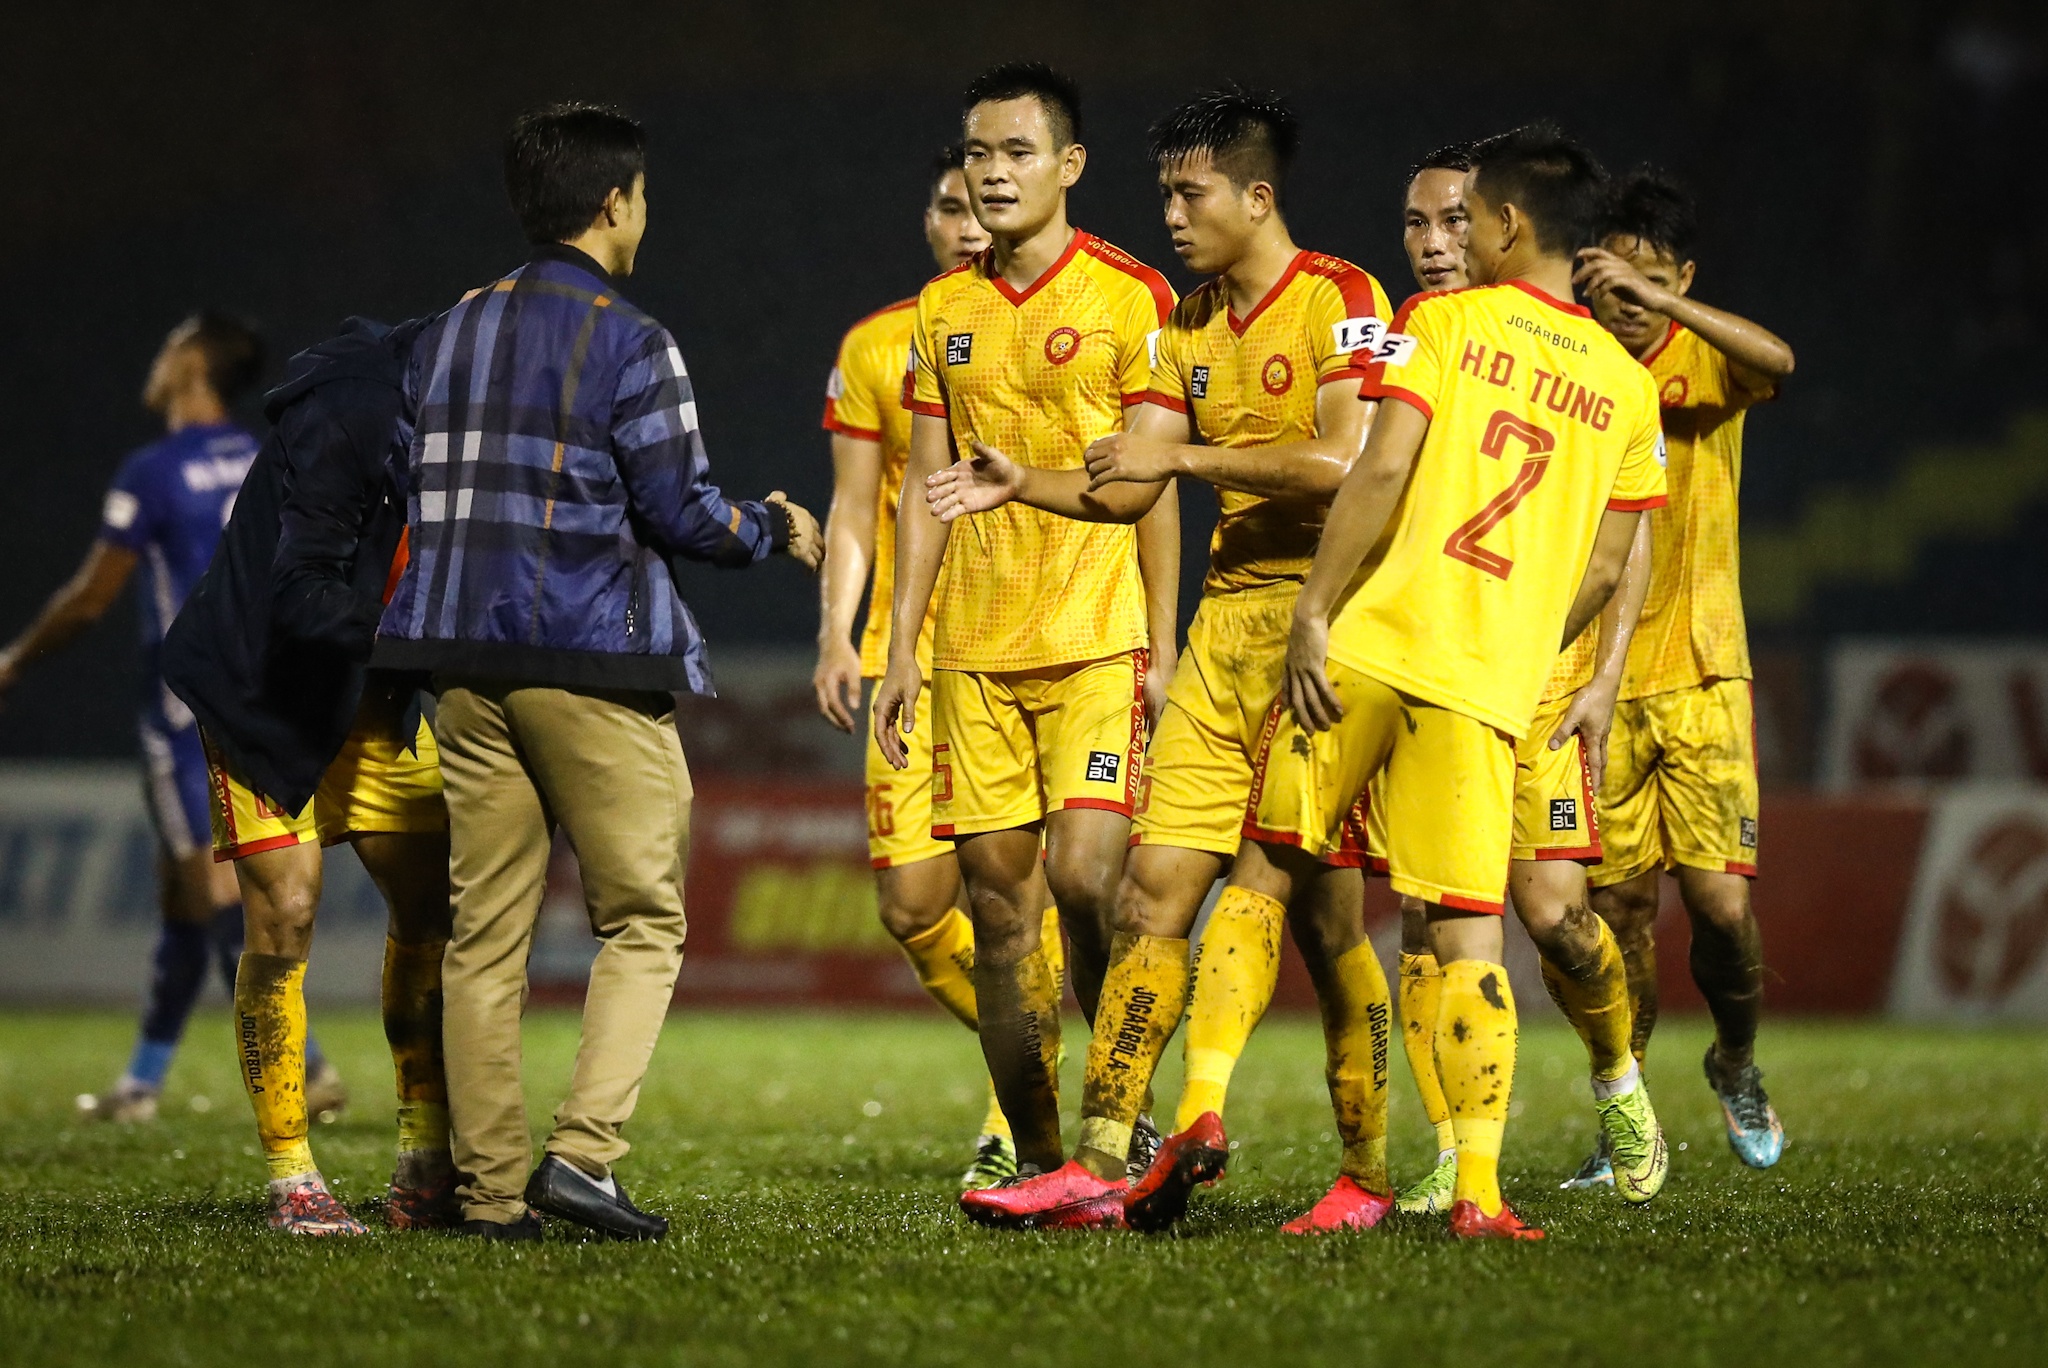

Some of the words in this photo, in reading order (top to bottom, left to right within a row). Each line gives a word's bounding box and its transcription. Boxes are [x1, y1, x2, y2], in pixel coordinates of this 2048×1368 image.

[948, 335, 971, 350] JG
[1506, 314, 1589, 356] JOGARBOLA
[948, 350, 969, 364] BL
[1373, 340, 1400, 359] S
[1192, 368, 1208, 382] JG
[1192, 383, 1205, 396] BL
[1459, 339, 1516, 392] H.Đ.
[1529, 367, 1615, 432] TÙNG
[1442, 409, 1556, 581] 2
[1090, 753, 1118, 768] JG
[1249, 703, 1281, 814] JOGARBOLA
[1088, 767, 1115, 781] BL
[1553, 801, 1575, 815] JG
[1552, 815, 1576, 829] BL
[1106, 986, 1158, 1071] JOGARBOLA
[241, 1010, 265, 1095] JOGARBOLA
[1366, 1002, 1388, 1092] JOGARBOLA
